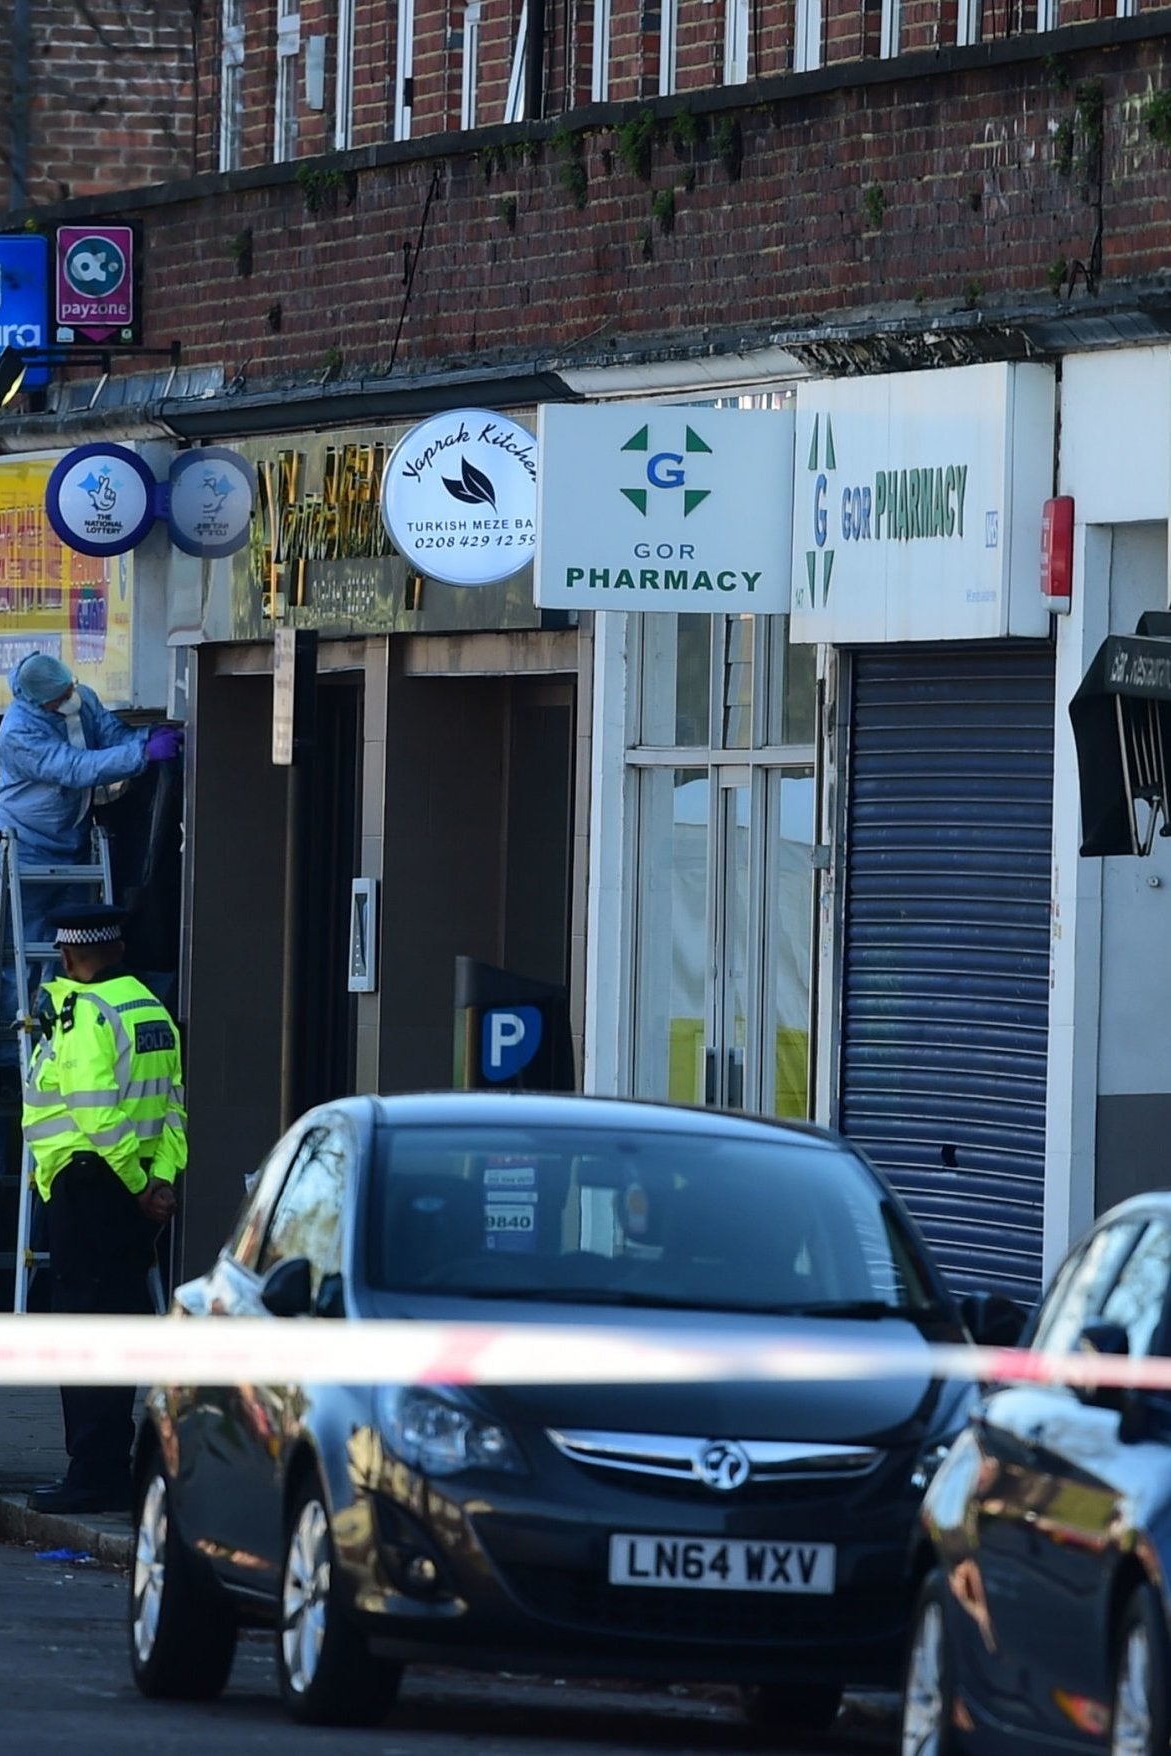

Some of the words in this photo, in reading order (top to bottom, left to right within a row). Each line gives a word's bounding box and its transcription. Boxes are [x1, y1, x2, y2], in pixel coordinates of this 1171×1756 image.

[61, 303, 128, 319] payzone
[402, 422, 471, 484] Yaprak
[647, 452, 687, 489] G
[813, 473, 828, 548] G
[841, 486, 872, 542] GOR
[875, 464, 968, 544] PHARMACY
[84, 520, 123, 528] NATIONAL
[97, 513, 112, 521] THE
[407, 521, 467, 532] TURKISH
[472, 519, 509, 530] MEZE
[86, 527, 122, 535] LOTTERY
[415, 537, 455, 549] 0208
[459, 535, 490, 548] 429
[496, 535, 514, 546] 12
[634, 543, 695, 560] GOR
[566, 567, 762, 592] PHARMACY
[491, 1013, 525, 1067] P
[628, 1541, 731, 1580] LN64
[744, 1546, 818, 1585] WXV
